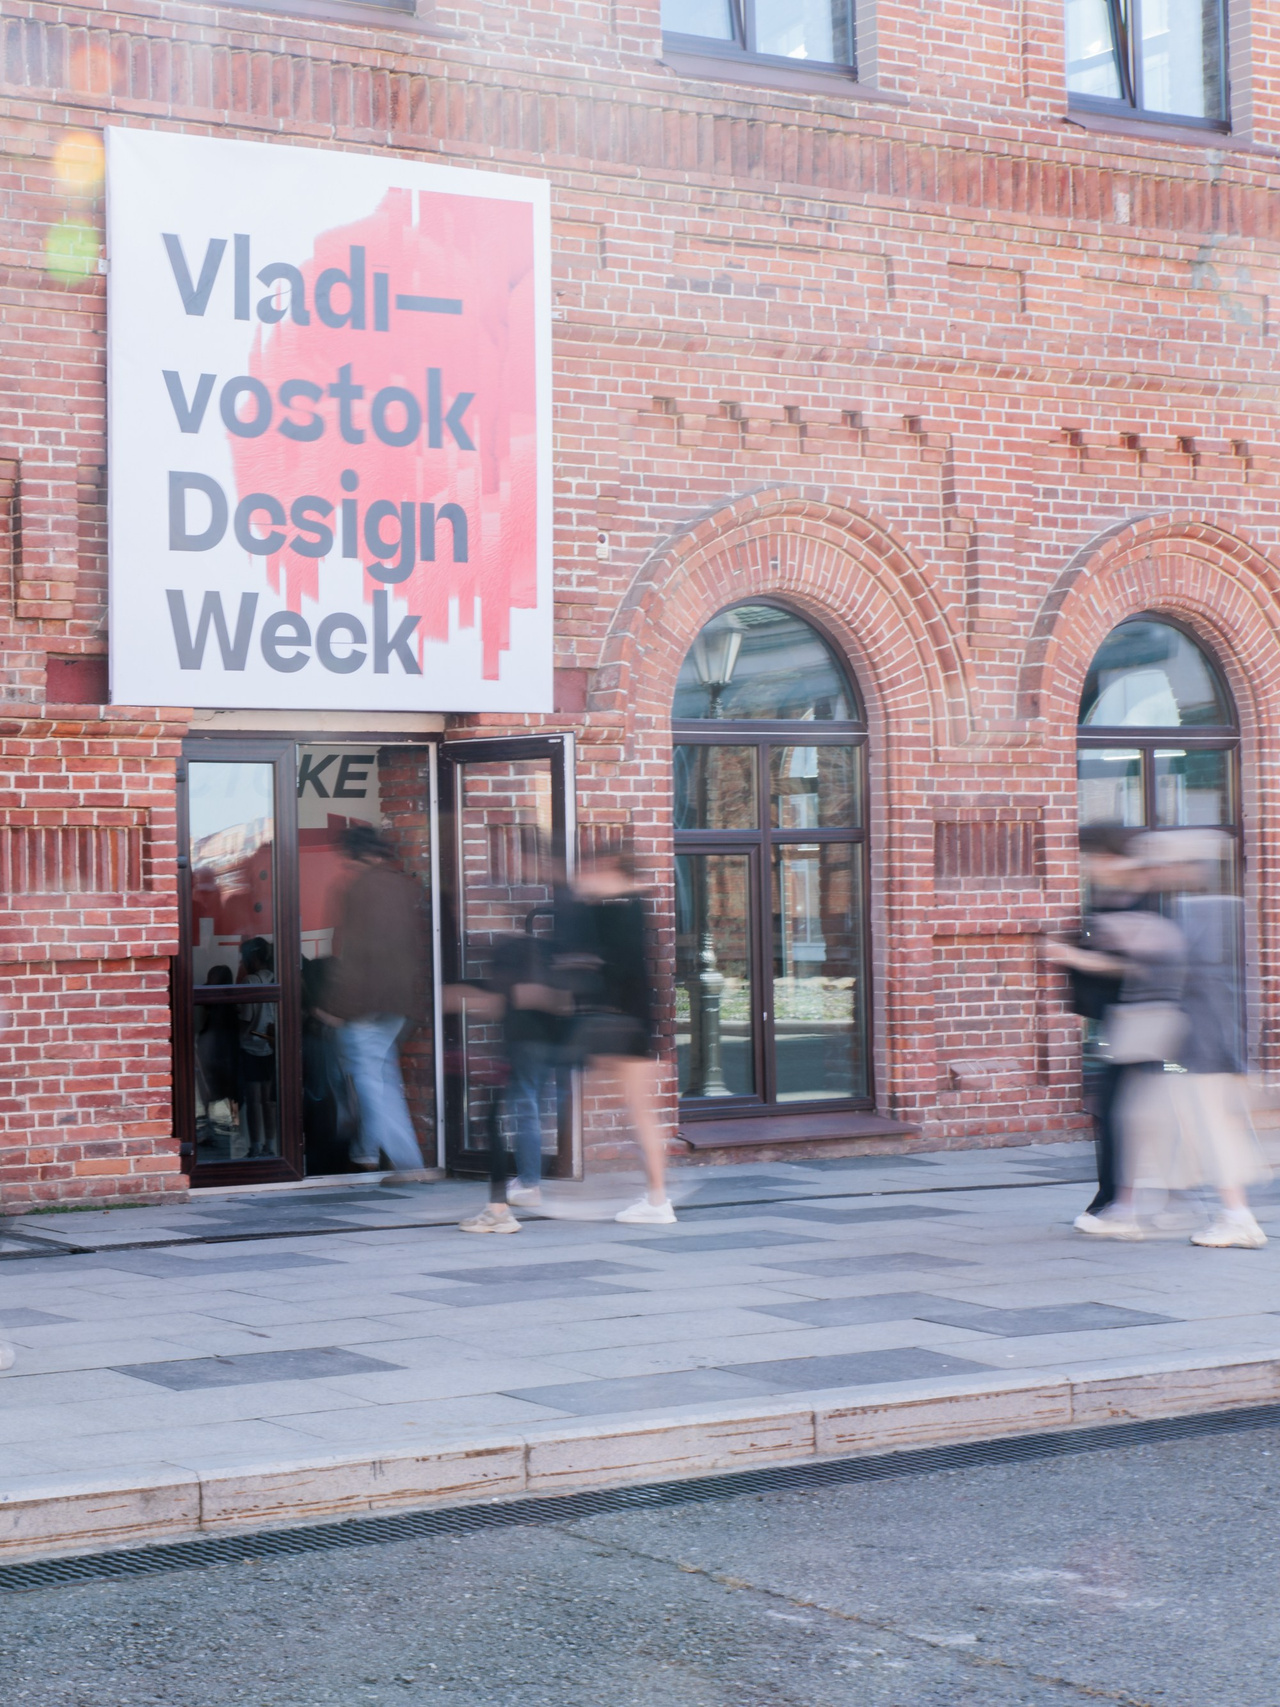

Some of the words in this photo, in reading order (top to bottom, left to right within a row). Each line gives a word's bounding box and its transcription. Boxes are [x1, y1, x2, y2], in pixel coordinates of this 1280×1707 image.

[161, 362, 477, 451] vostok
[167, 468, 469, 584] Design
[165, 588, 423, 675] Week
